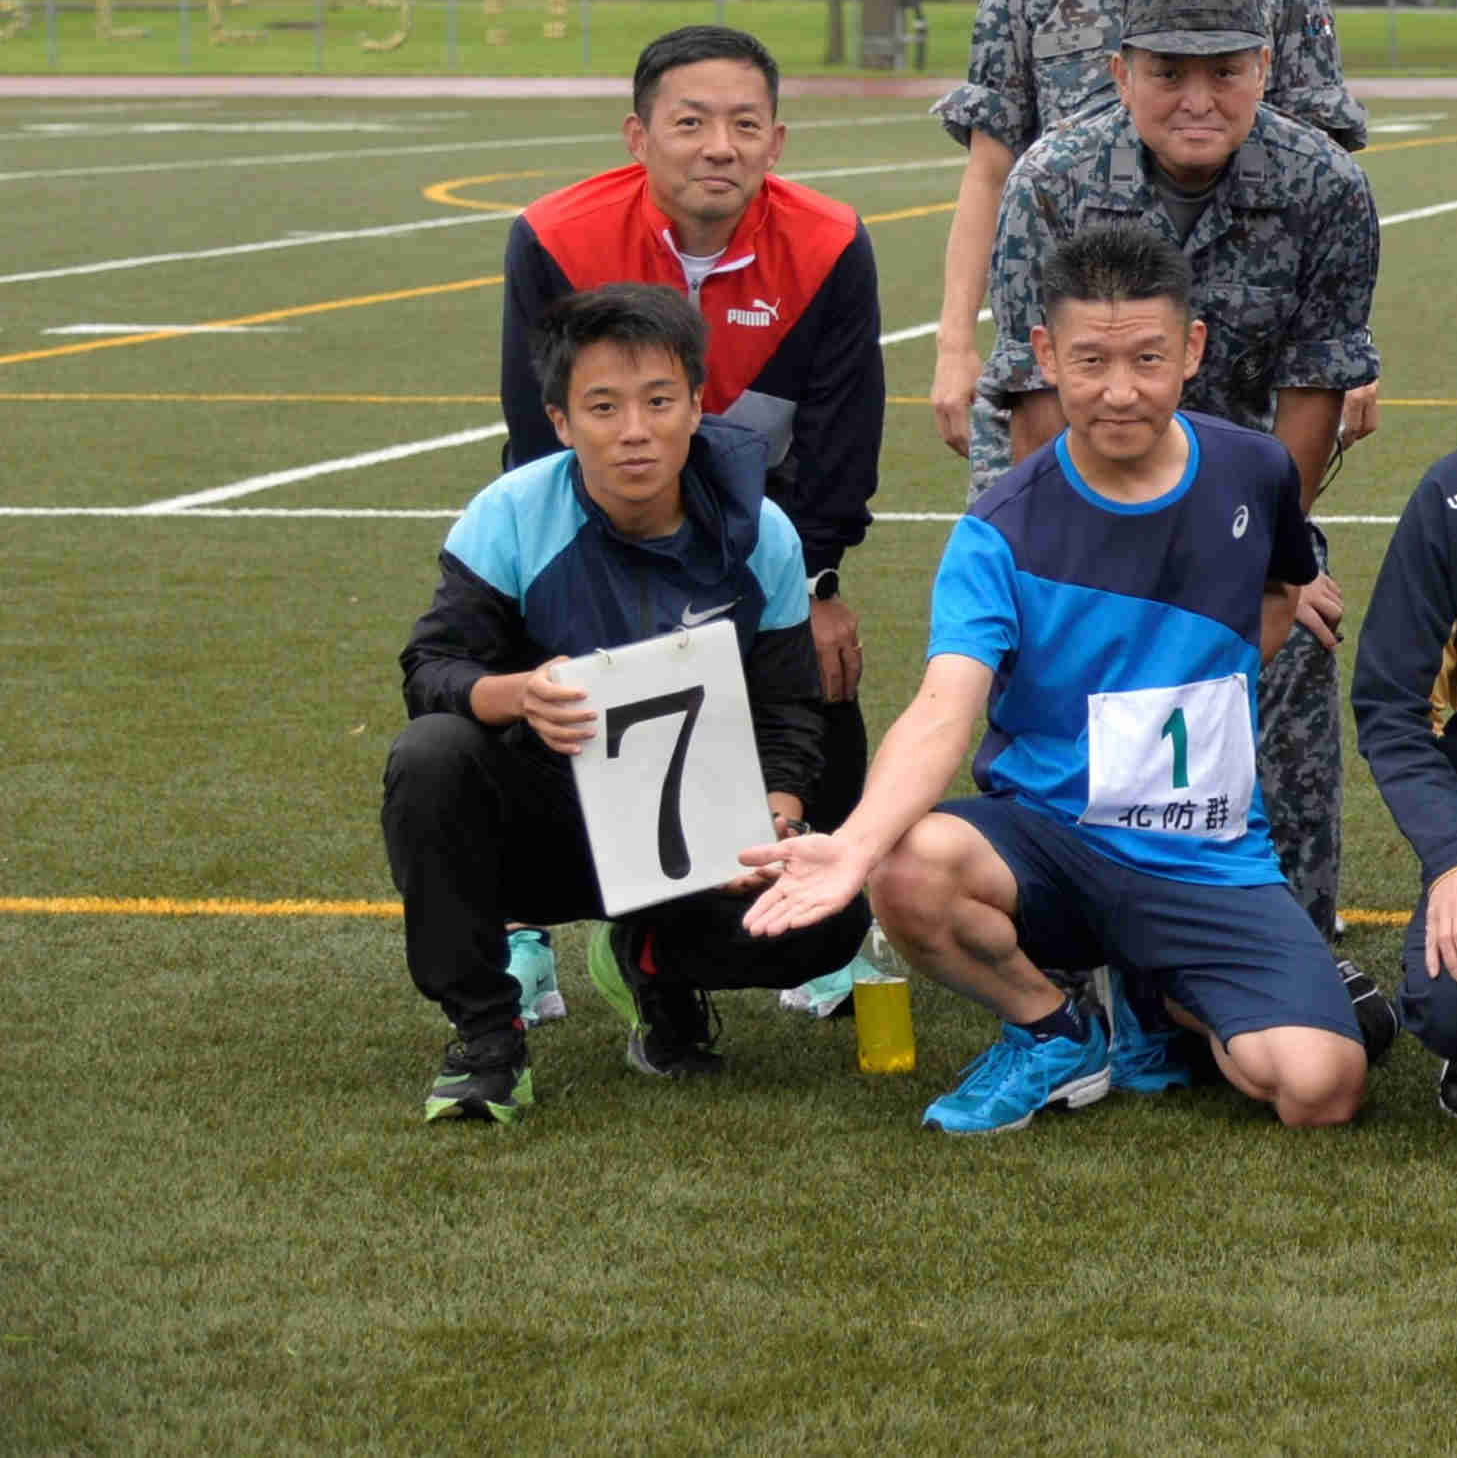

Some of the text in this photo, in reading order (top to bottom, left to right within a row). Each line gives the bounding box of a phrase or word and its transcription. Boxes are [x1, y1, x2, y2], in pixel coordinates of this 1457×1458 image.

[727, 308, 770, 327] PUMA
[1161, 707, 1190, 789] 1
[606, 684, 705, 881] 7
[1118, 793, 1230, 831] 北防群
